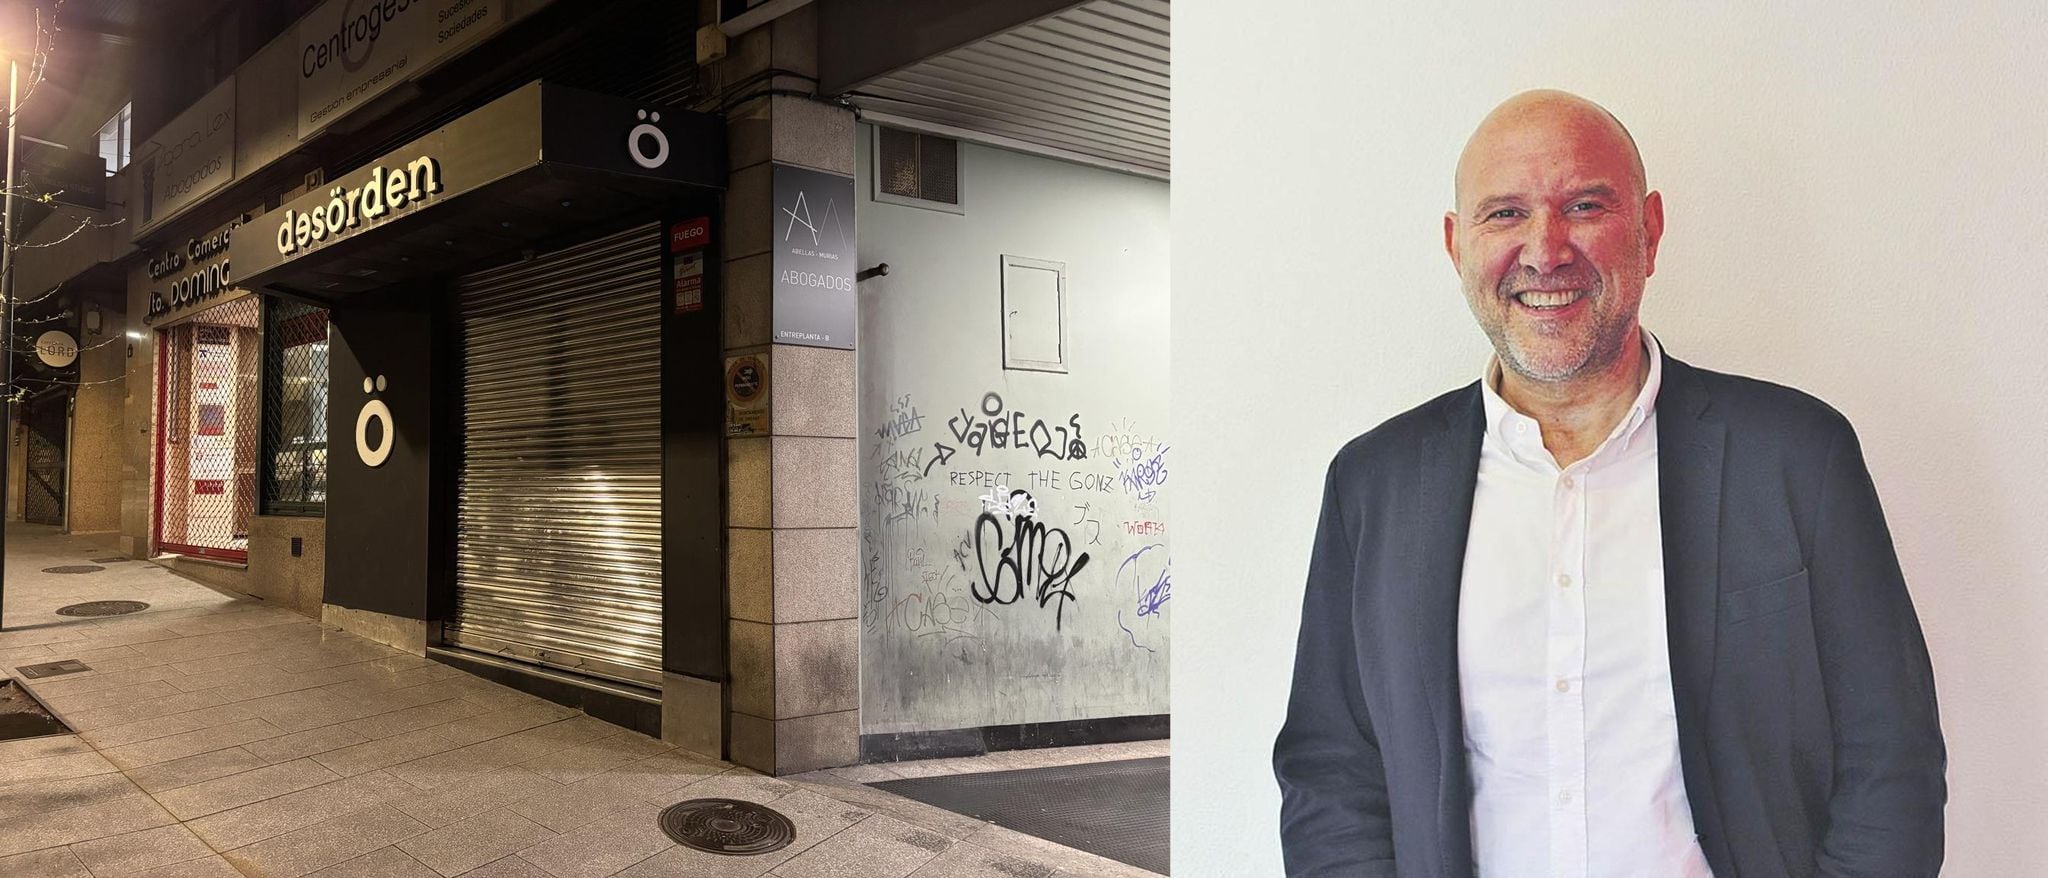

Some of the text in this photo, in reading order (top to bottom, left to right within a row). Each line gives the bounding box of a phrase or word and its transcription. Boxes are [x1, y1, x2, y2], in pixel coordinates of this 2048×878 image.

[437, 0, 474, 24] Sucesio
[437, 6, 488, 44] Sociedades
[302, 0, 419, 79] Centroge
[346, 55, 408, 101] empresarial
[163, 156, 222, 201] Abogados
[147, 213, 244, 278] Centro Comerc
[673, 226, 704, 242] FUEGO
[170, 258, 230, 307] DOMING
[781, 270, 852, 292] ABOGADOS
[780, 330, 821, 341] ENTREPLANTA
[950, 470, 1012, 489] RESPECT
[1028, 470, 1062, 490] THE
[1069, 471, 1115, 493] GONZ
